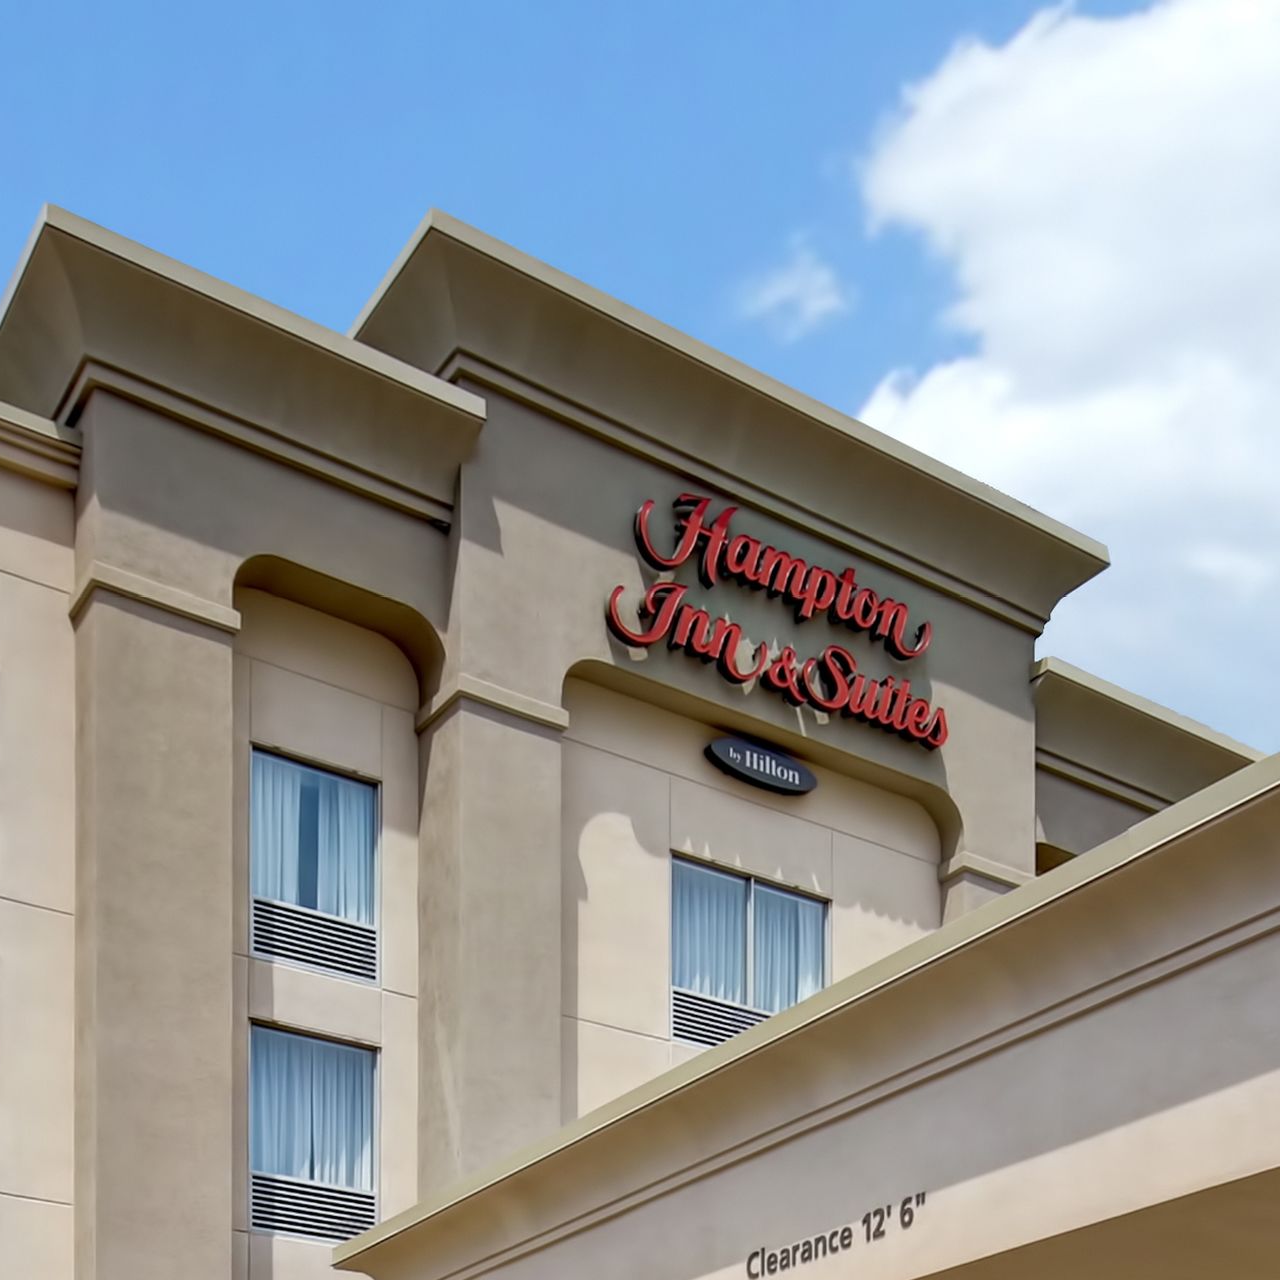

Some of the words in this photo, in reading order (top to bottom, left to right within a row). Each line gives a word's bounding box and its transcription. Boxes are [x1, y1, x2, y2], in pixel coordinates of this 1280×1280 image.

[634, 493, 932, 659] Hampton
[607, 582, 767, 684] Inn
[762, 646, 807, 706] &
[802, 645, 949, 751] Suites
[729, 747, 741, 763] by
[745, 750, 800, 785] Hilton
[746, 1225, 853, 1280] Clearance
[861, 1205, 891, 1244] 12'
[899, 1191, 927, 1229] 6"
